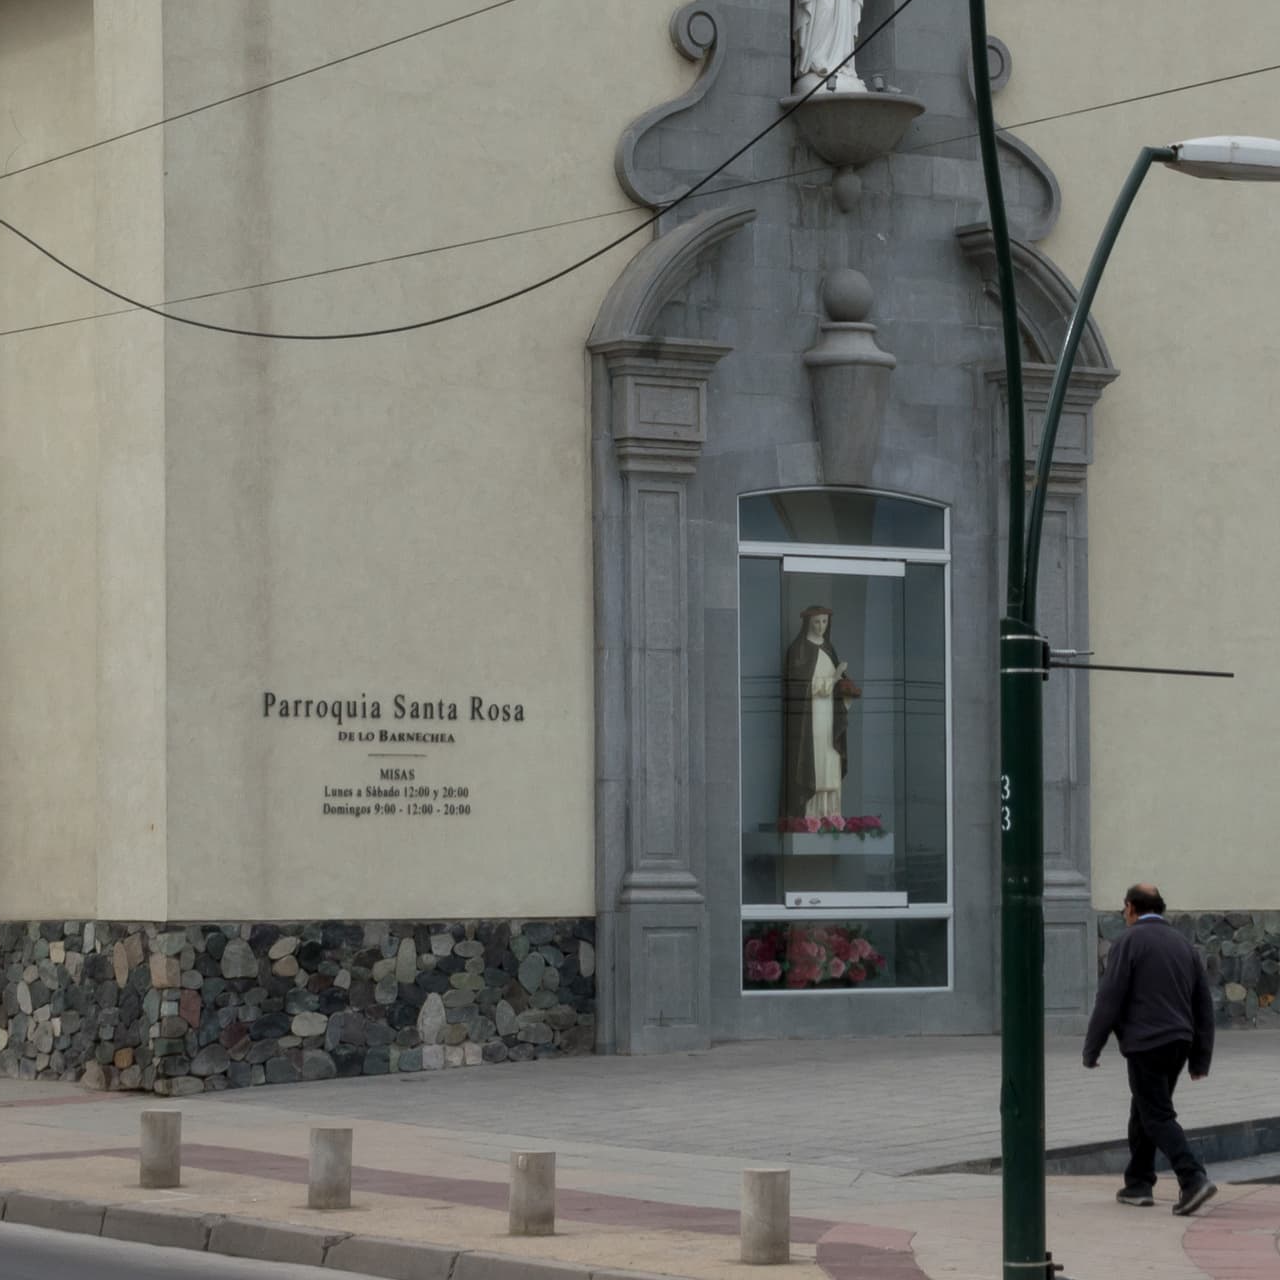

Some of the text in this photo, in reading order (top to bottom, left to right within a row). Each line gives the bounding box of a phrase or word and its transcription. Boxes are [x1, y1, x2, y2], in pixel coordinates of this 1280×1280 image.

[263, 691, 525, 726] Parroquia Santa Rosa
[379, 768, 416, 781] MISAS
[324, 785, 353, 798] Lunes
[356, 788, 362, 798] a
[404, 786, 430, 798] 12:00
[432, 789, 439, 801] y
[442, 786, 470, 799] 20:00
[323, 802, 371, 818] Domingos
[374, 803, 397, 815] 9:00
[407, 803, 434, 816] 12:00
[443, 803, 471, 816] 20:00
